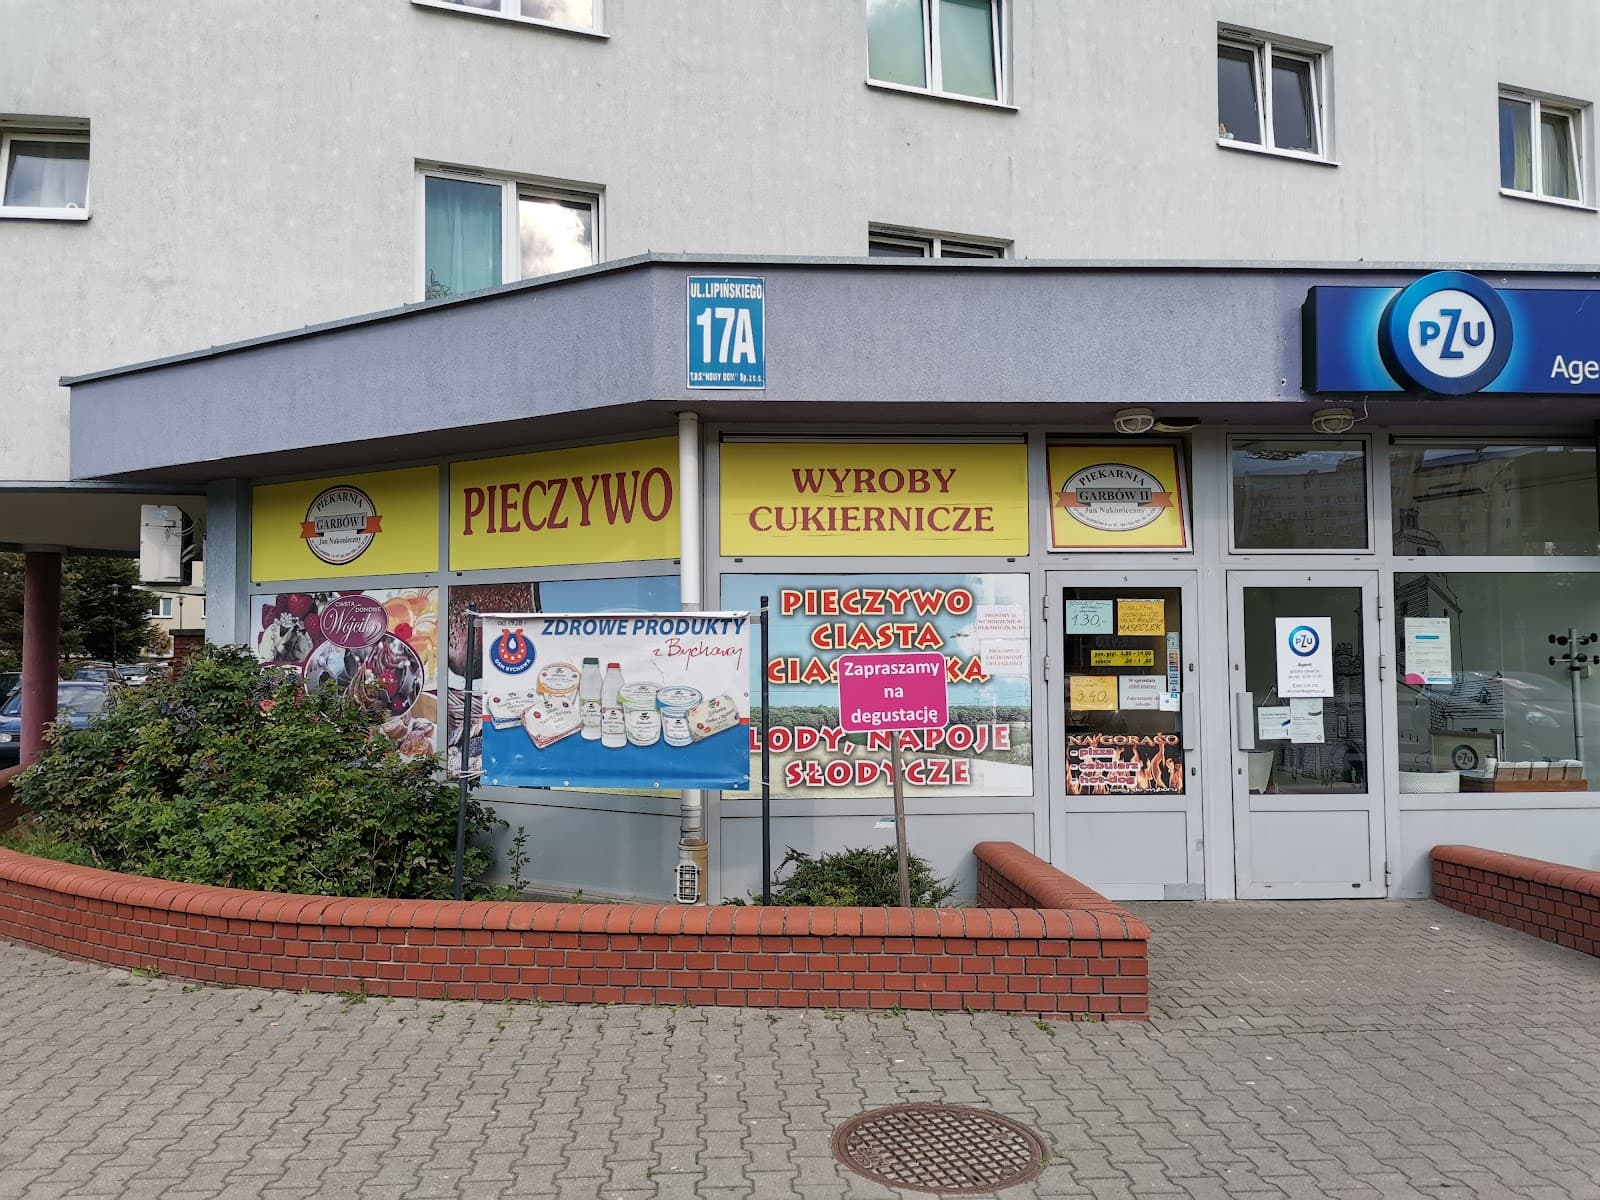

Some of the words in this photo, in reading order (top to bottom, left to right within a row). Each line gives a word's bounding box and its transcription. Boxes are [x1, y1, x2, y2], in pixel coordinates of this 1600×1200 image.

[696, 307, 757, 364] 17A
[1419, 308, 1486, 359] PZU
[792, 468, 957, 493] WYROBY
[1078, 469, 1145, 487] PIEKARNIA
[316, 492, 363, 512] PIEKARNIA
[463, 466, 673, 536] PIECZYWO
[1079, 487, 1136, 502] GARBÓW
[1140, 490, 1150, 501] II
[316, 514, 358, 531] GARBÓW
[360, 516, 365, 529] I
[748, 506, 995, 532] CUKIERNICZE
[780, 588, 973, 616] PIECZYWO
[541, 619, 627, 636] ZDROWE
[630, 618, 746, 636] PRODUKTY
[810, 622, 944, 649] CIASTA
[1296, 634, 1312, 648] PZU
[652, 648, 663, 656] z
[665, 637, 743, 671] Bychawy
[843, 660, 940, 679] Zapraszamy
[884, 687, 904, 698] na
[851, 706, 938, 725] degustację
[868, 723, 1011, 755] NAPOJE
[1068, 735, 1094, 745] NA
[1100, 734, 1179, 746] GORĄCO
[1079, 748, 1114, 757] pizza
[1458, 752, 1473, 765] PZU
[785, 758, 971, 787] SŁODYCZE
[1079, 761, 1139, 770] cebularz
[1079, 775, 1136, 785] hot-dog
